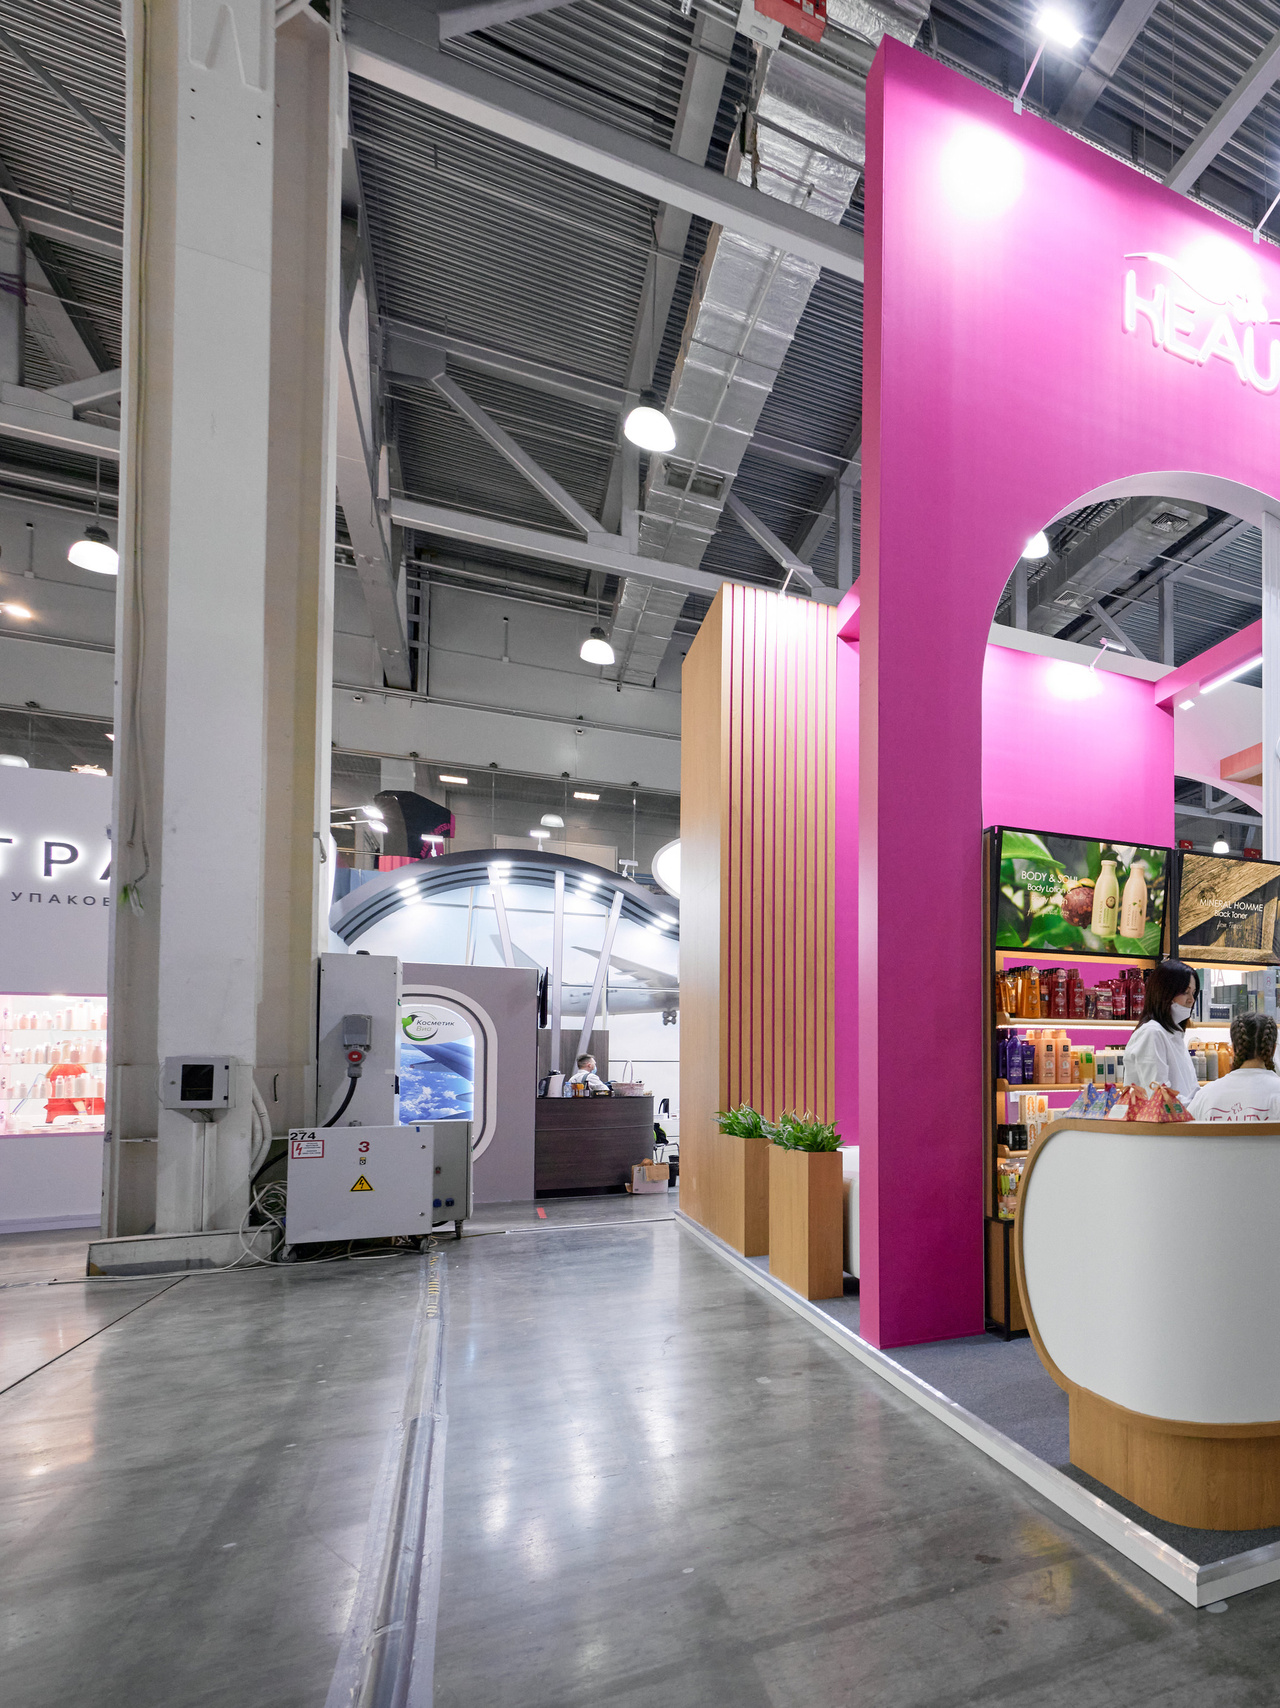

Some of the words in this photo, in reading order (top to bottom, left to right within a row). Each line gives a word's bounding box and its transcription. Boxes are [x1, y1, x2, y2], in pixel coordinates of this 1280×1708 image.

[1021, 870, 1048, 882] BODY
[1048, 873, 1057, 884] &
[1027, 883, 1045, 893] Body
[1200, 899, 1232, 909] MINERAL
[1233, 901, 1264, 912] HOMME
[1214, 910, 1231, 918] Black
[1231, 911, 1248, 920] Toner
[416, 1019, 455, 1027] Косметик
[290, 1131, 316, 1140] 274
[358, 1141, 370, 1152] 3
